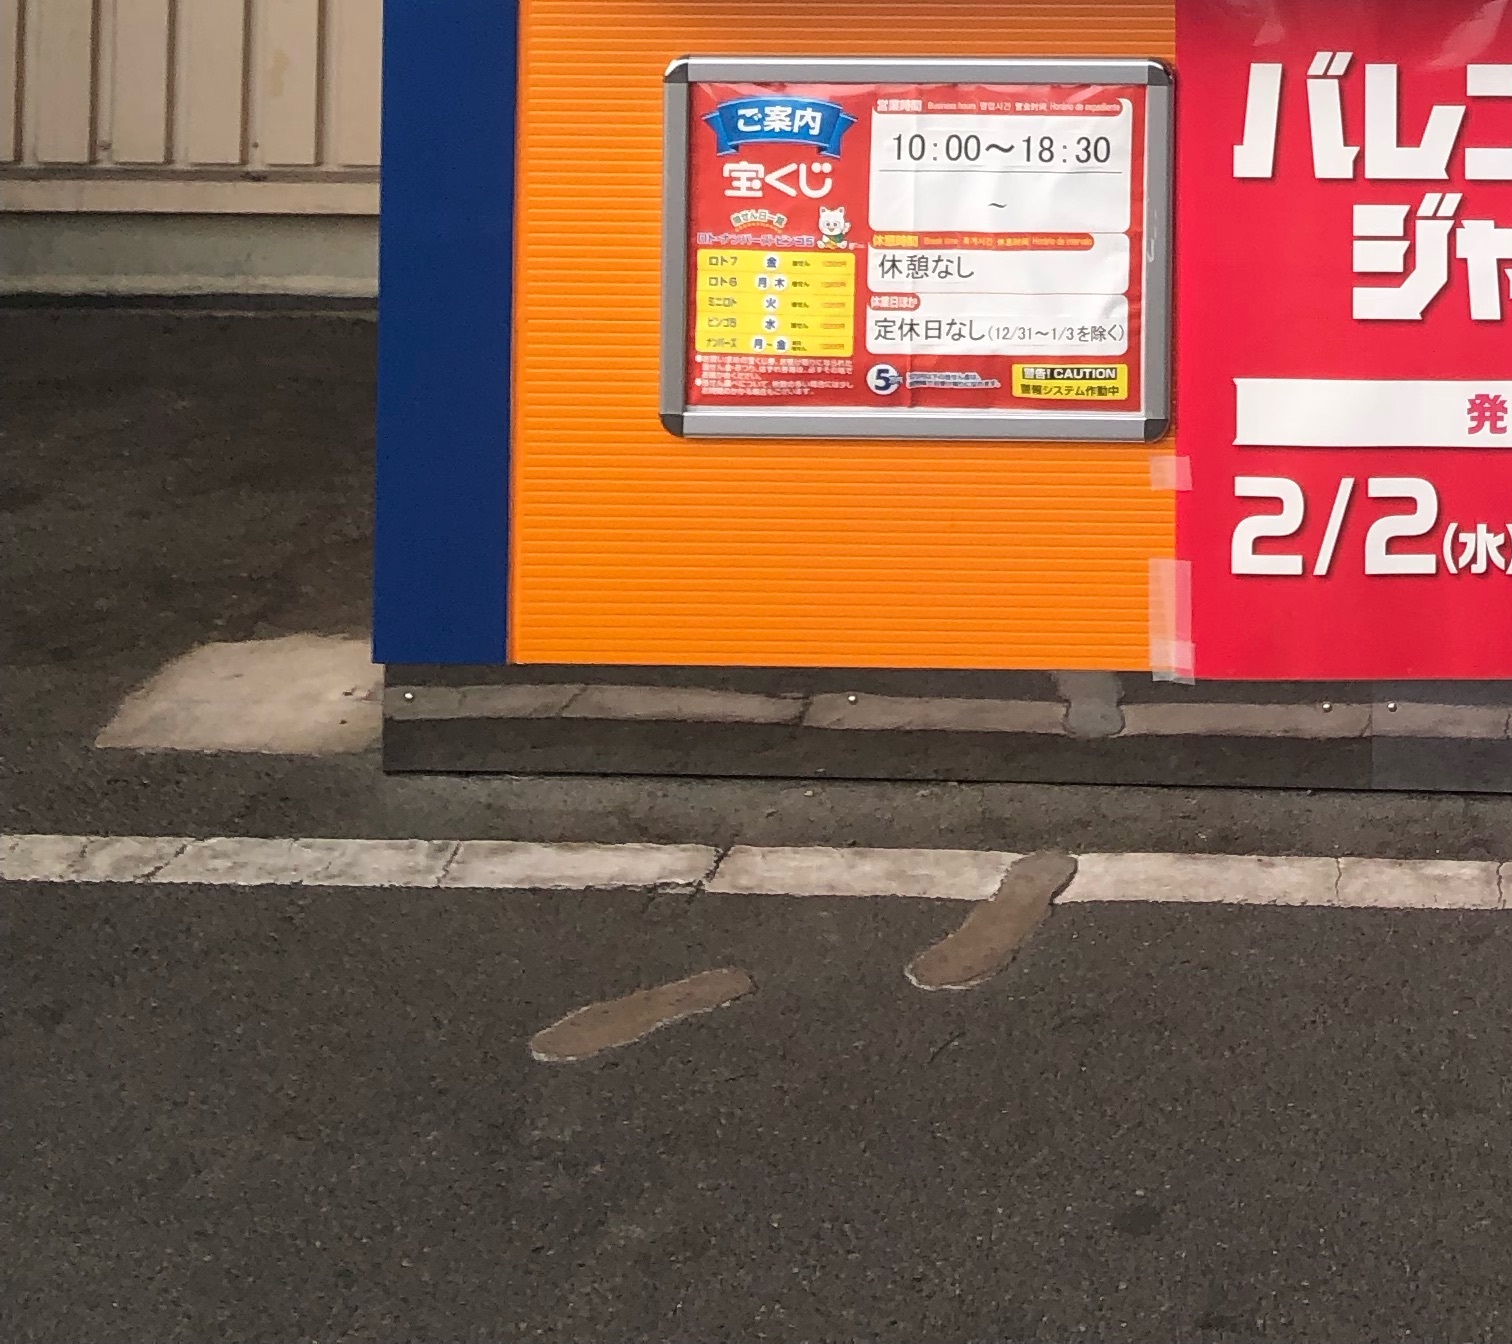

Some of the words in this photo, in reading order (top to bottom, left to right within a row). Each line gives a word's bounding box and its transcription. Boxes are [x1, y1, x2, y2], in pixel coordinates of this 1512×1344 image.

[736, 105, 823, 134] ご案内
[722, 160, 834, 199] 宝くじ
[878, 253, 975, 280] 休憩なし
[1053, 367, 1118, 380] CAUTION
